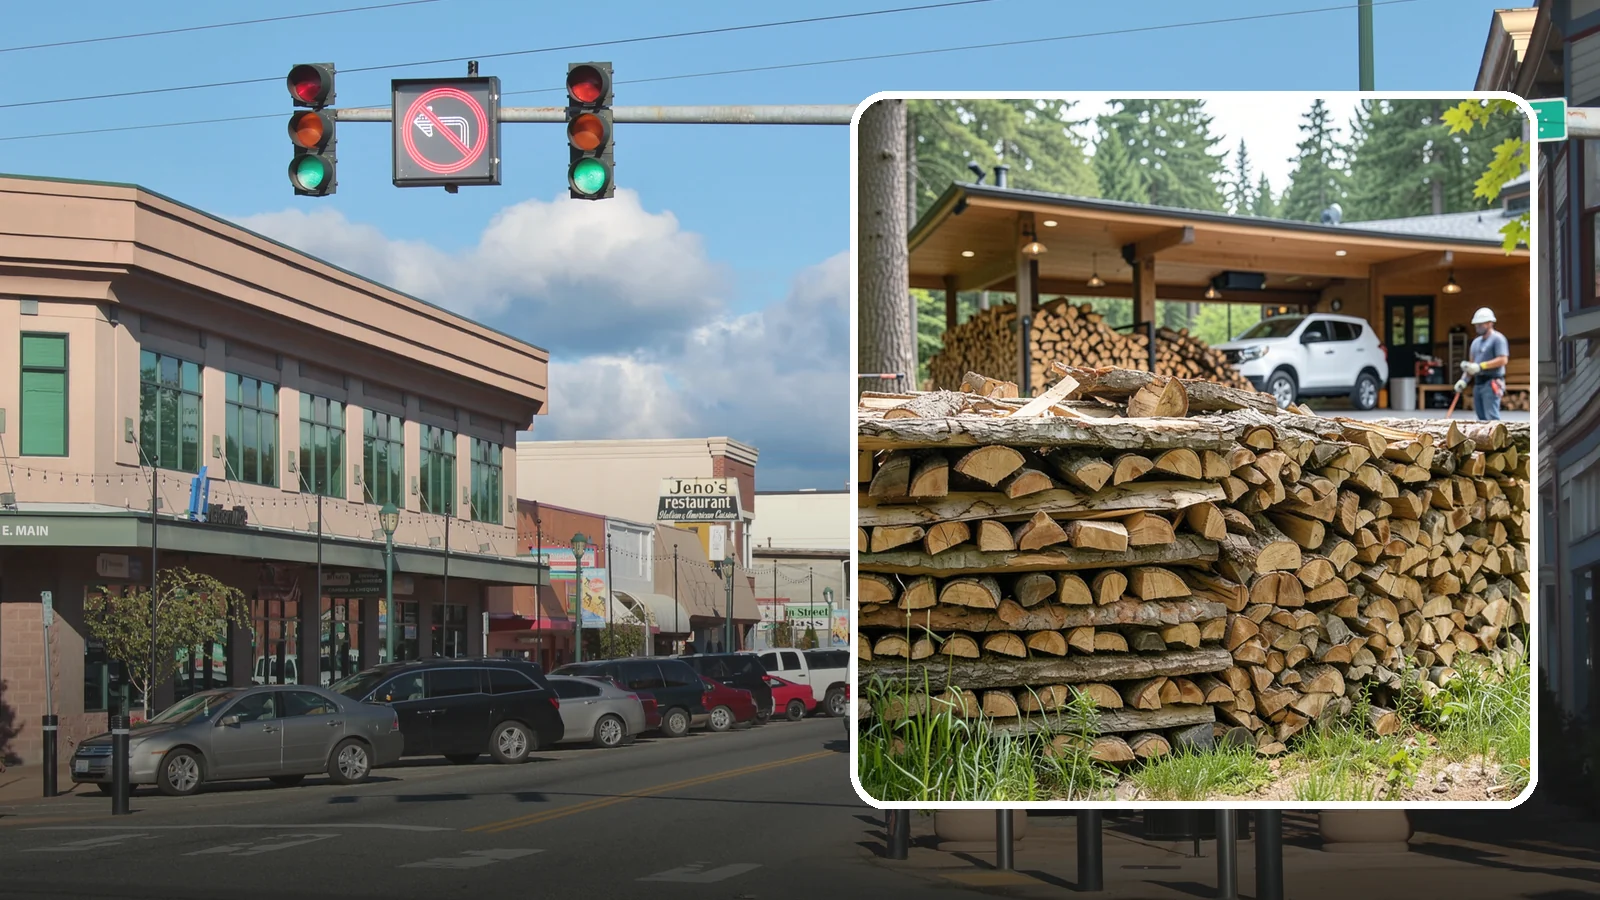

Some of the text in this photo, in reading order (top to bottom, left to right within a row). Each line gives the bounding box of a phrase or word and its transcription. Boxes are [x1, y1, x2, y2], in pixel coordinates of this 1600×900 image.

[670, 480, 727, 494] Jeno's
[665, 496, 730, 508] restaurant
[659, 510, 682, 519] Italian
[686, 510, 714, 519] American
[715, 510, 737, 519] Cuisine
[2, 525, 48, 535] E. MAIN
[785, 608, 795, 617] in
[797, 607, 828, 617] Street
